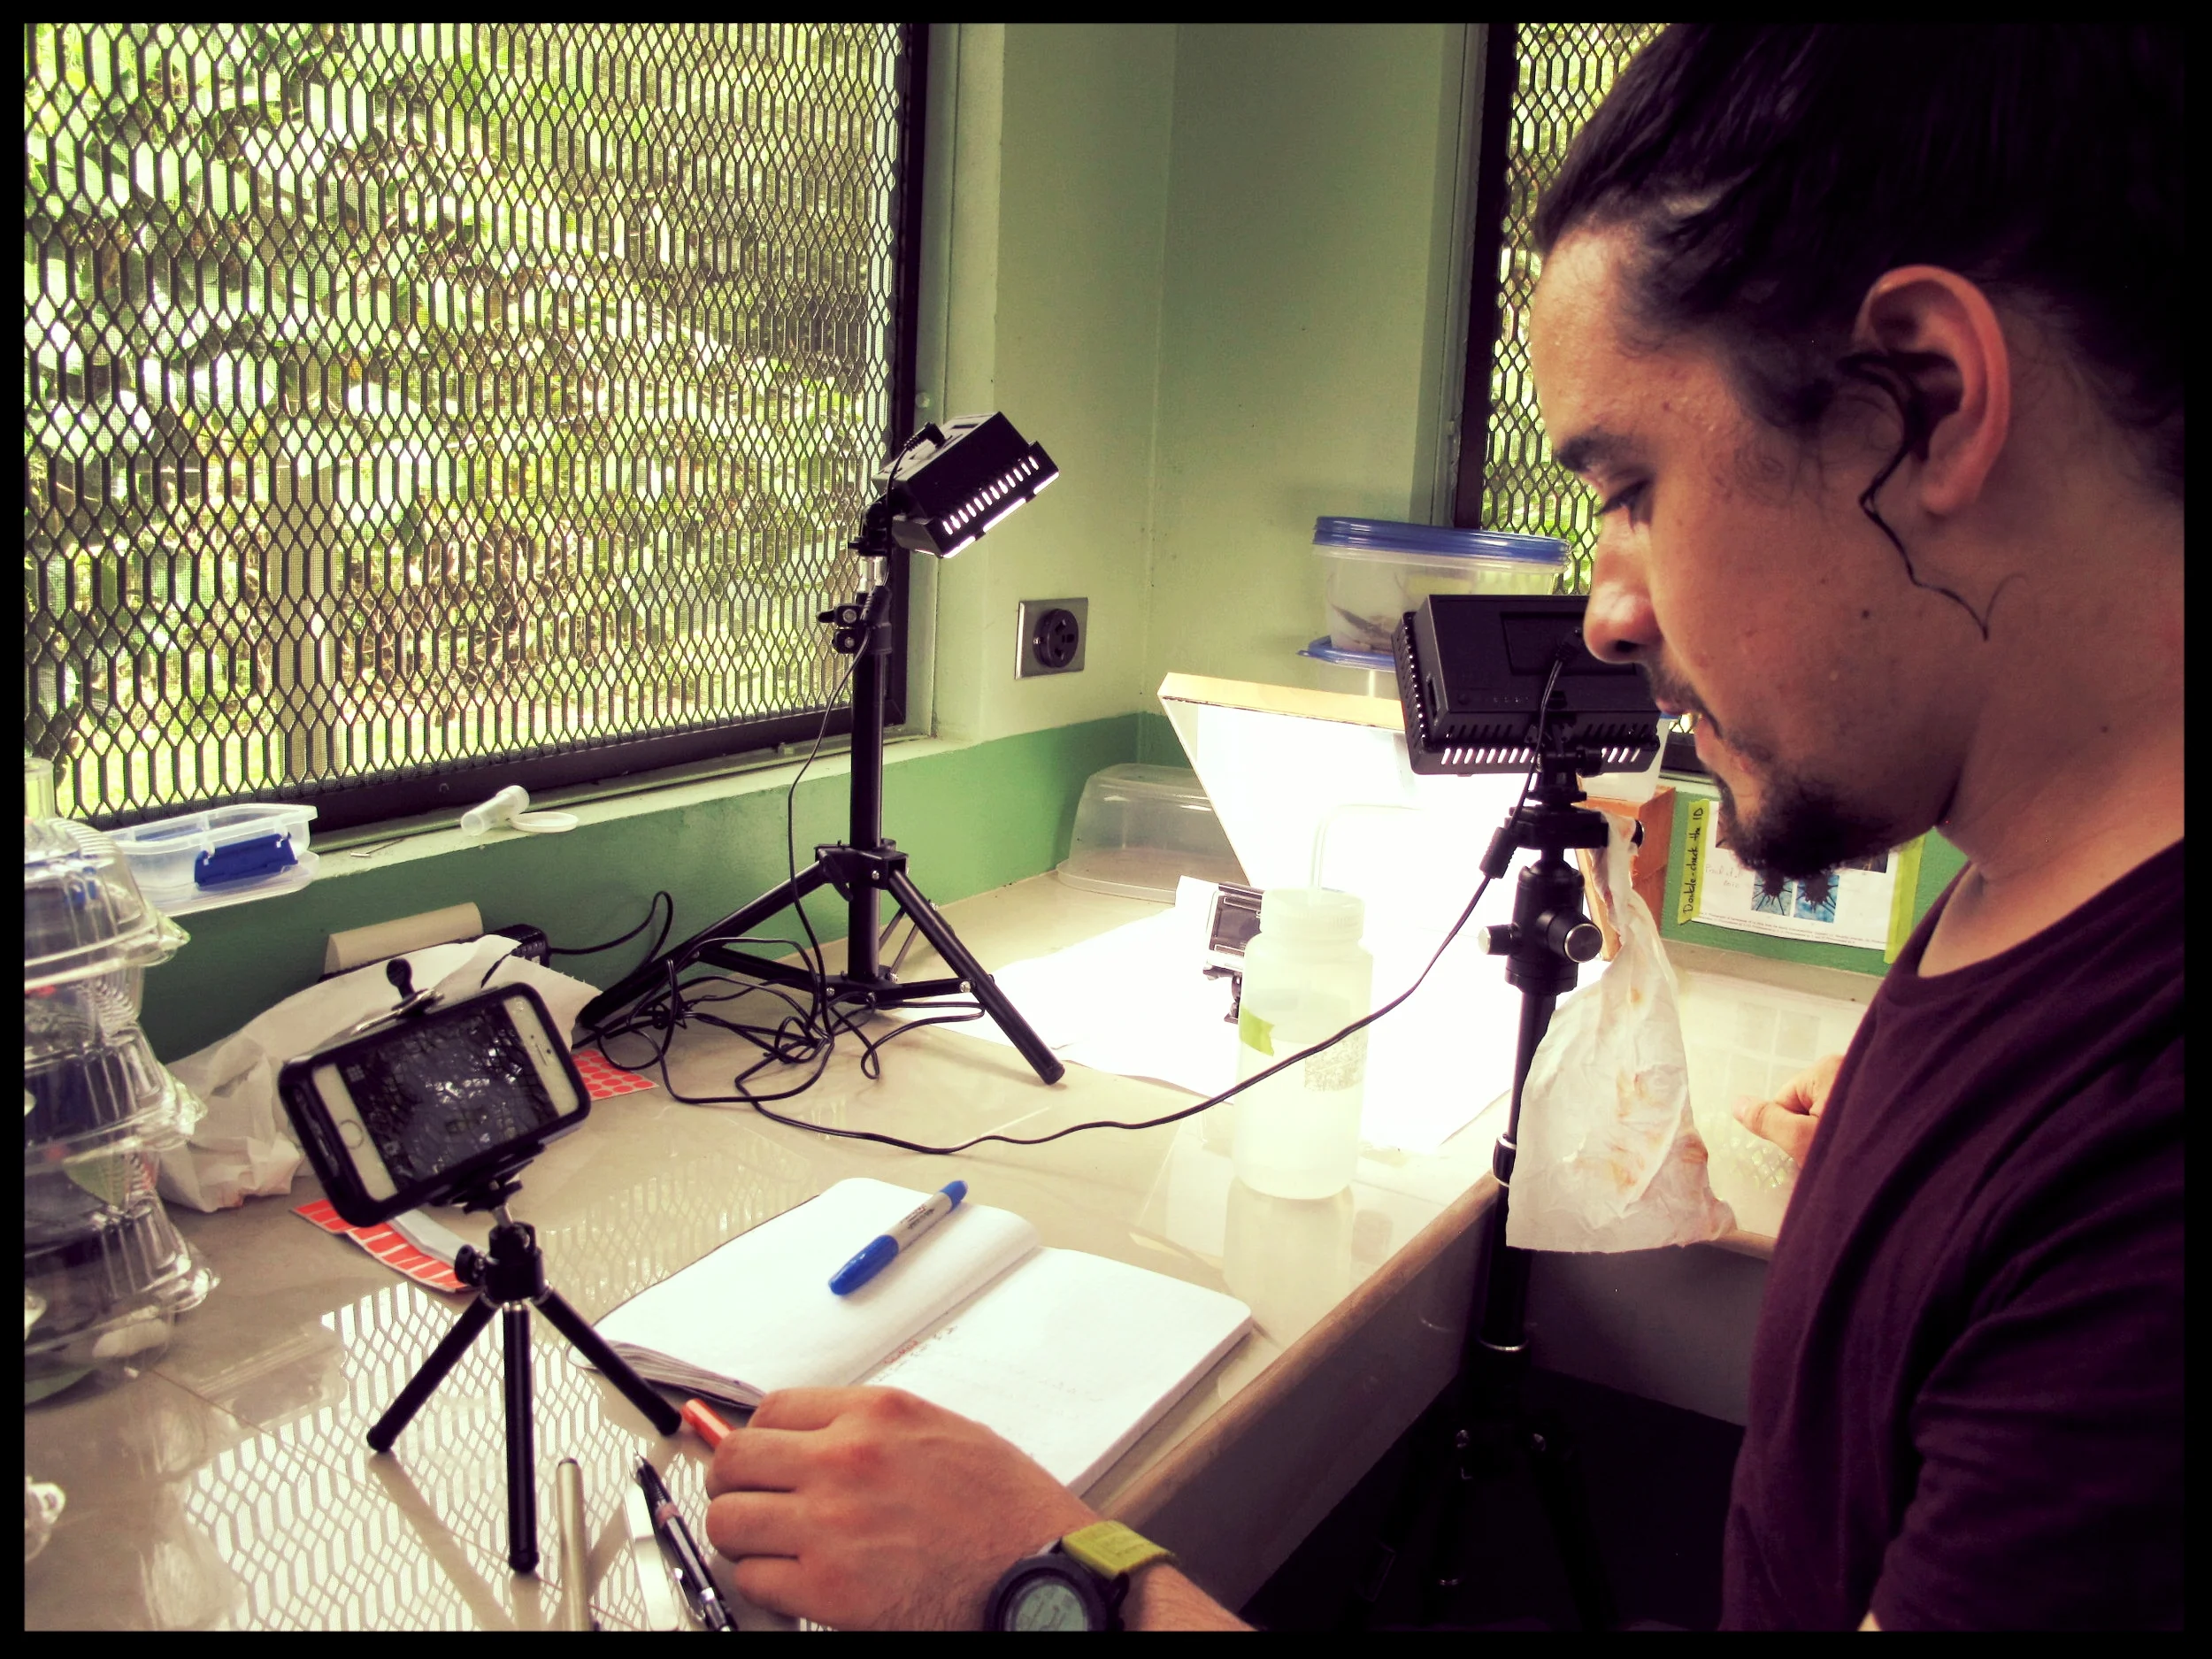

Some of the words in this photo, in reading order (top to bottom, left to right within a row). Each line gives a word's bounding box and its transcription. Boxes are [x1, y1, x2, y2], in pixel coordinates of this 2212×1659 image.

[1693, 807, 1703, 820] ID
[1688, 827, 1701, 841] the
[1683, 846, 1698, 913] Double-check
